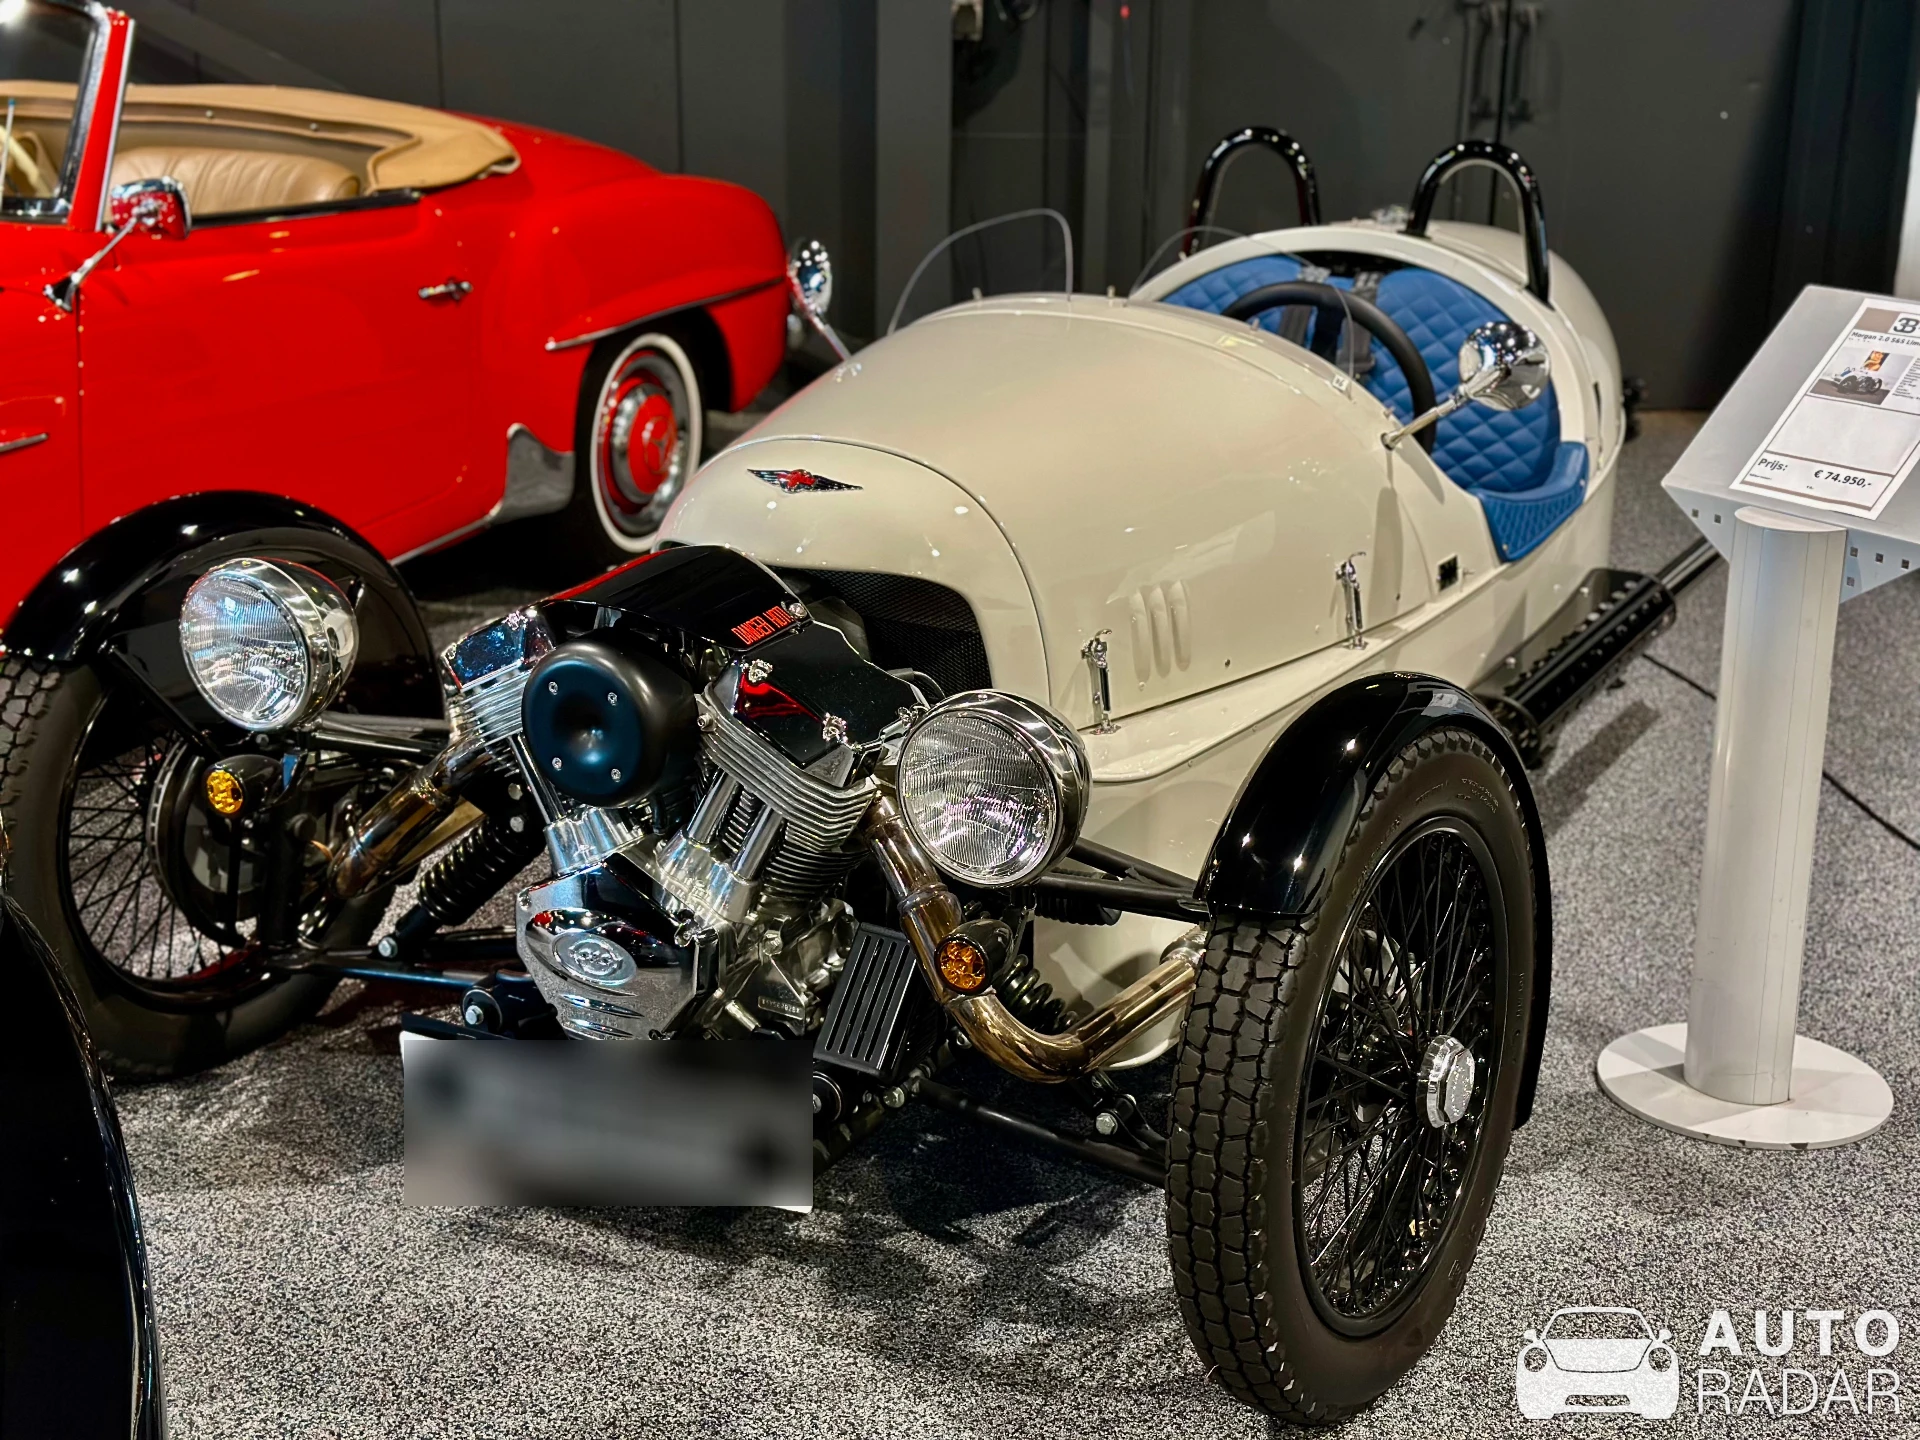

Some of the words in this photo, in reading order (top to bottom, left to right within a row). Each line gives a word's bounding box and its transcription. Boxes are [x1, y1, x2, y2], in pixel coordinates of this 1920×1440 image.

[1851, 331, 1877, 340] Morgan
[1758, 458, 1788, 471] Prijs:
[1814, 469, 1823, 478] €
[1824, 471, 1872, 488] 74.950,-
